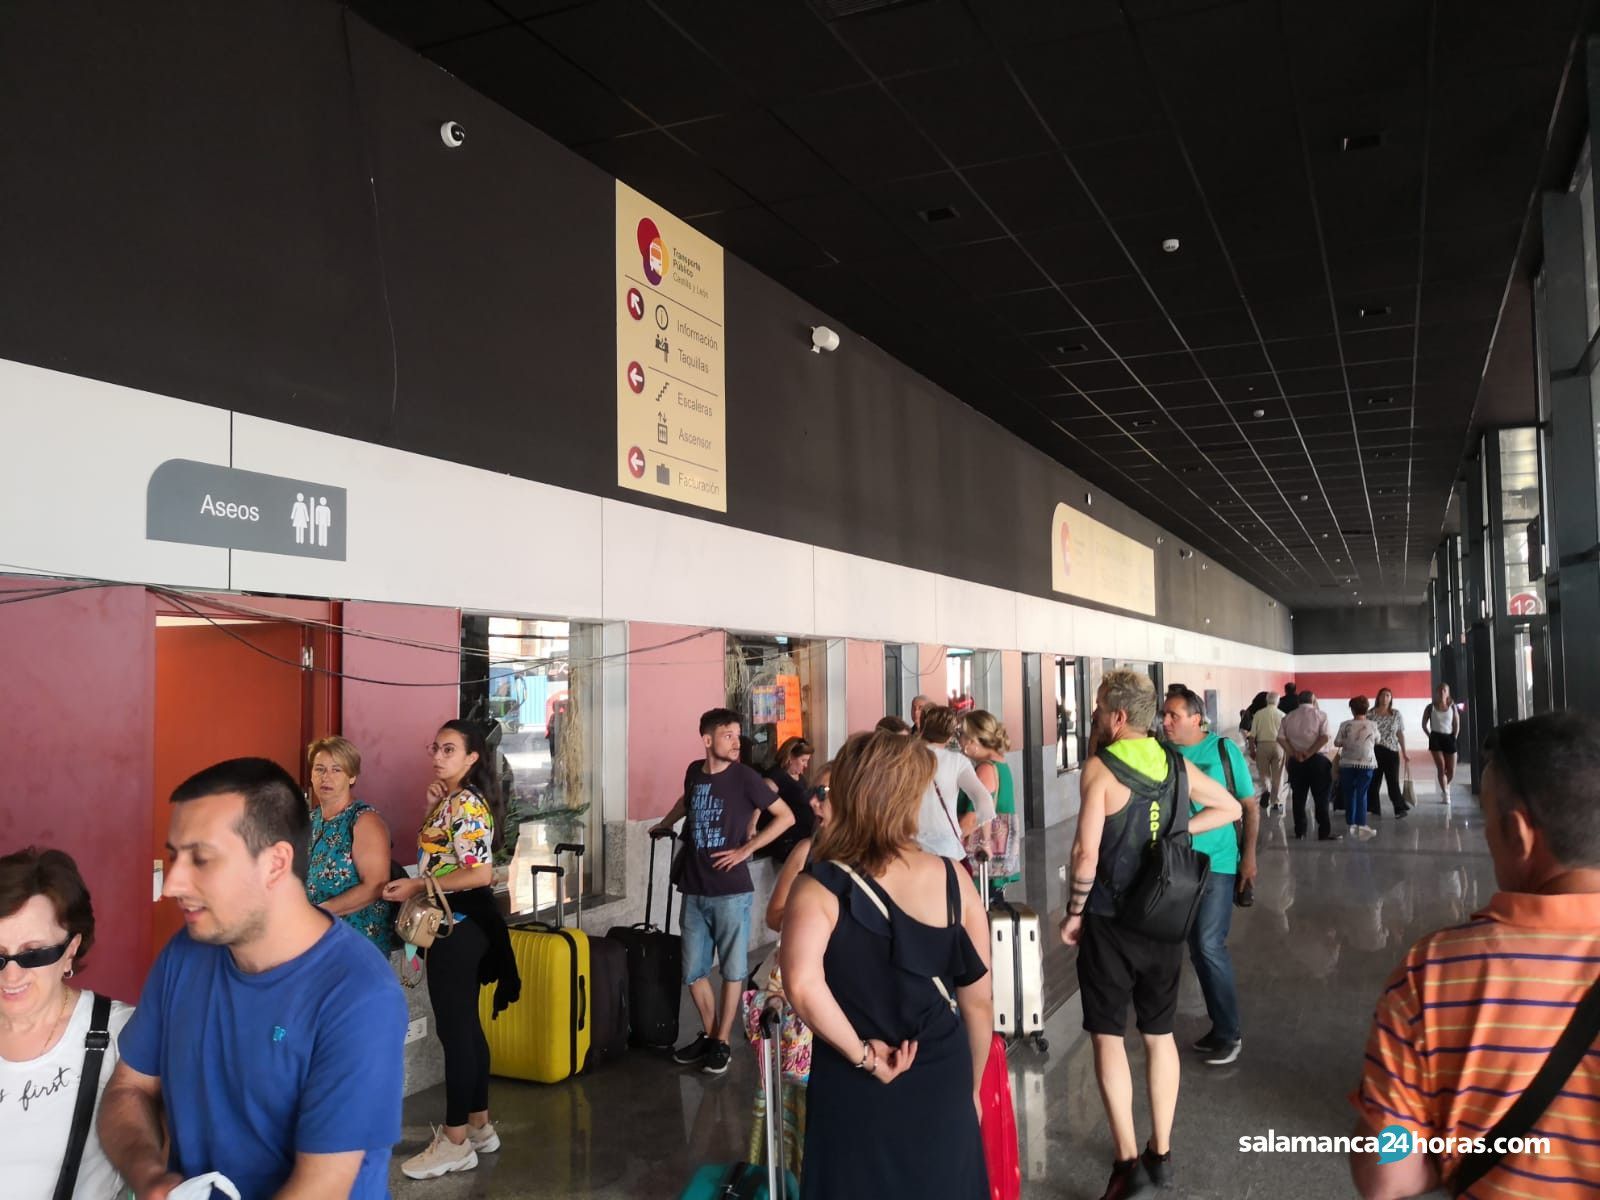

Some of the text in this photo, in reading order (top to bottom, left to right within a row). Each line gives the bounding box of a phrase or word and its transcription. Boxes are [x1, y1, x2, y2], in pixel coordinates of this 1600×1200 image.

[677, 319, 718, 351] Información
[677, 347, 709, 374] Taquillas
[678, 392, 713, 417] Escaleras
[678, 427, 712, 450] Ascensor
[678, 471, 720, 496] Facturación
[199, 493, 260, 522] Aseos
[1514, 599, 1536, 615] 12
[18, 1067, 71, 1112] first
